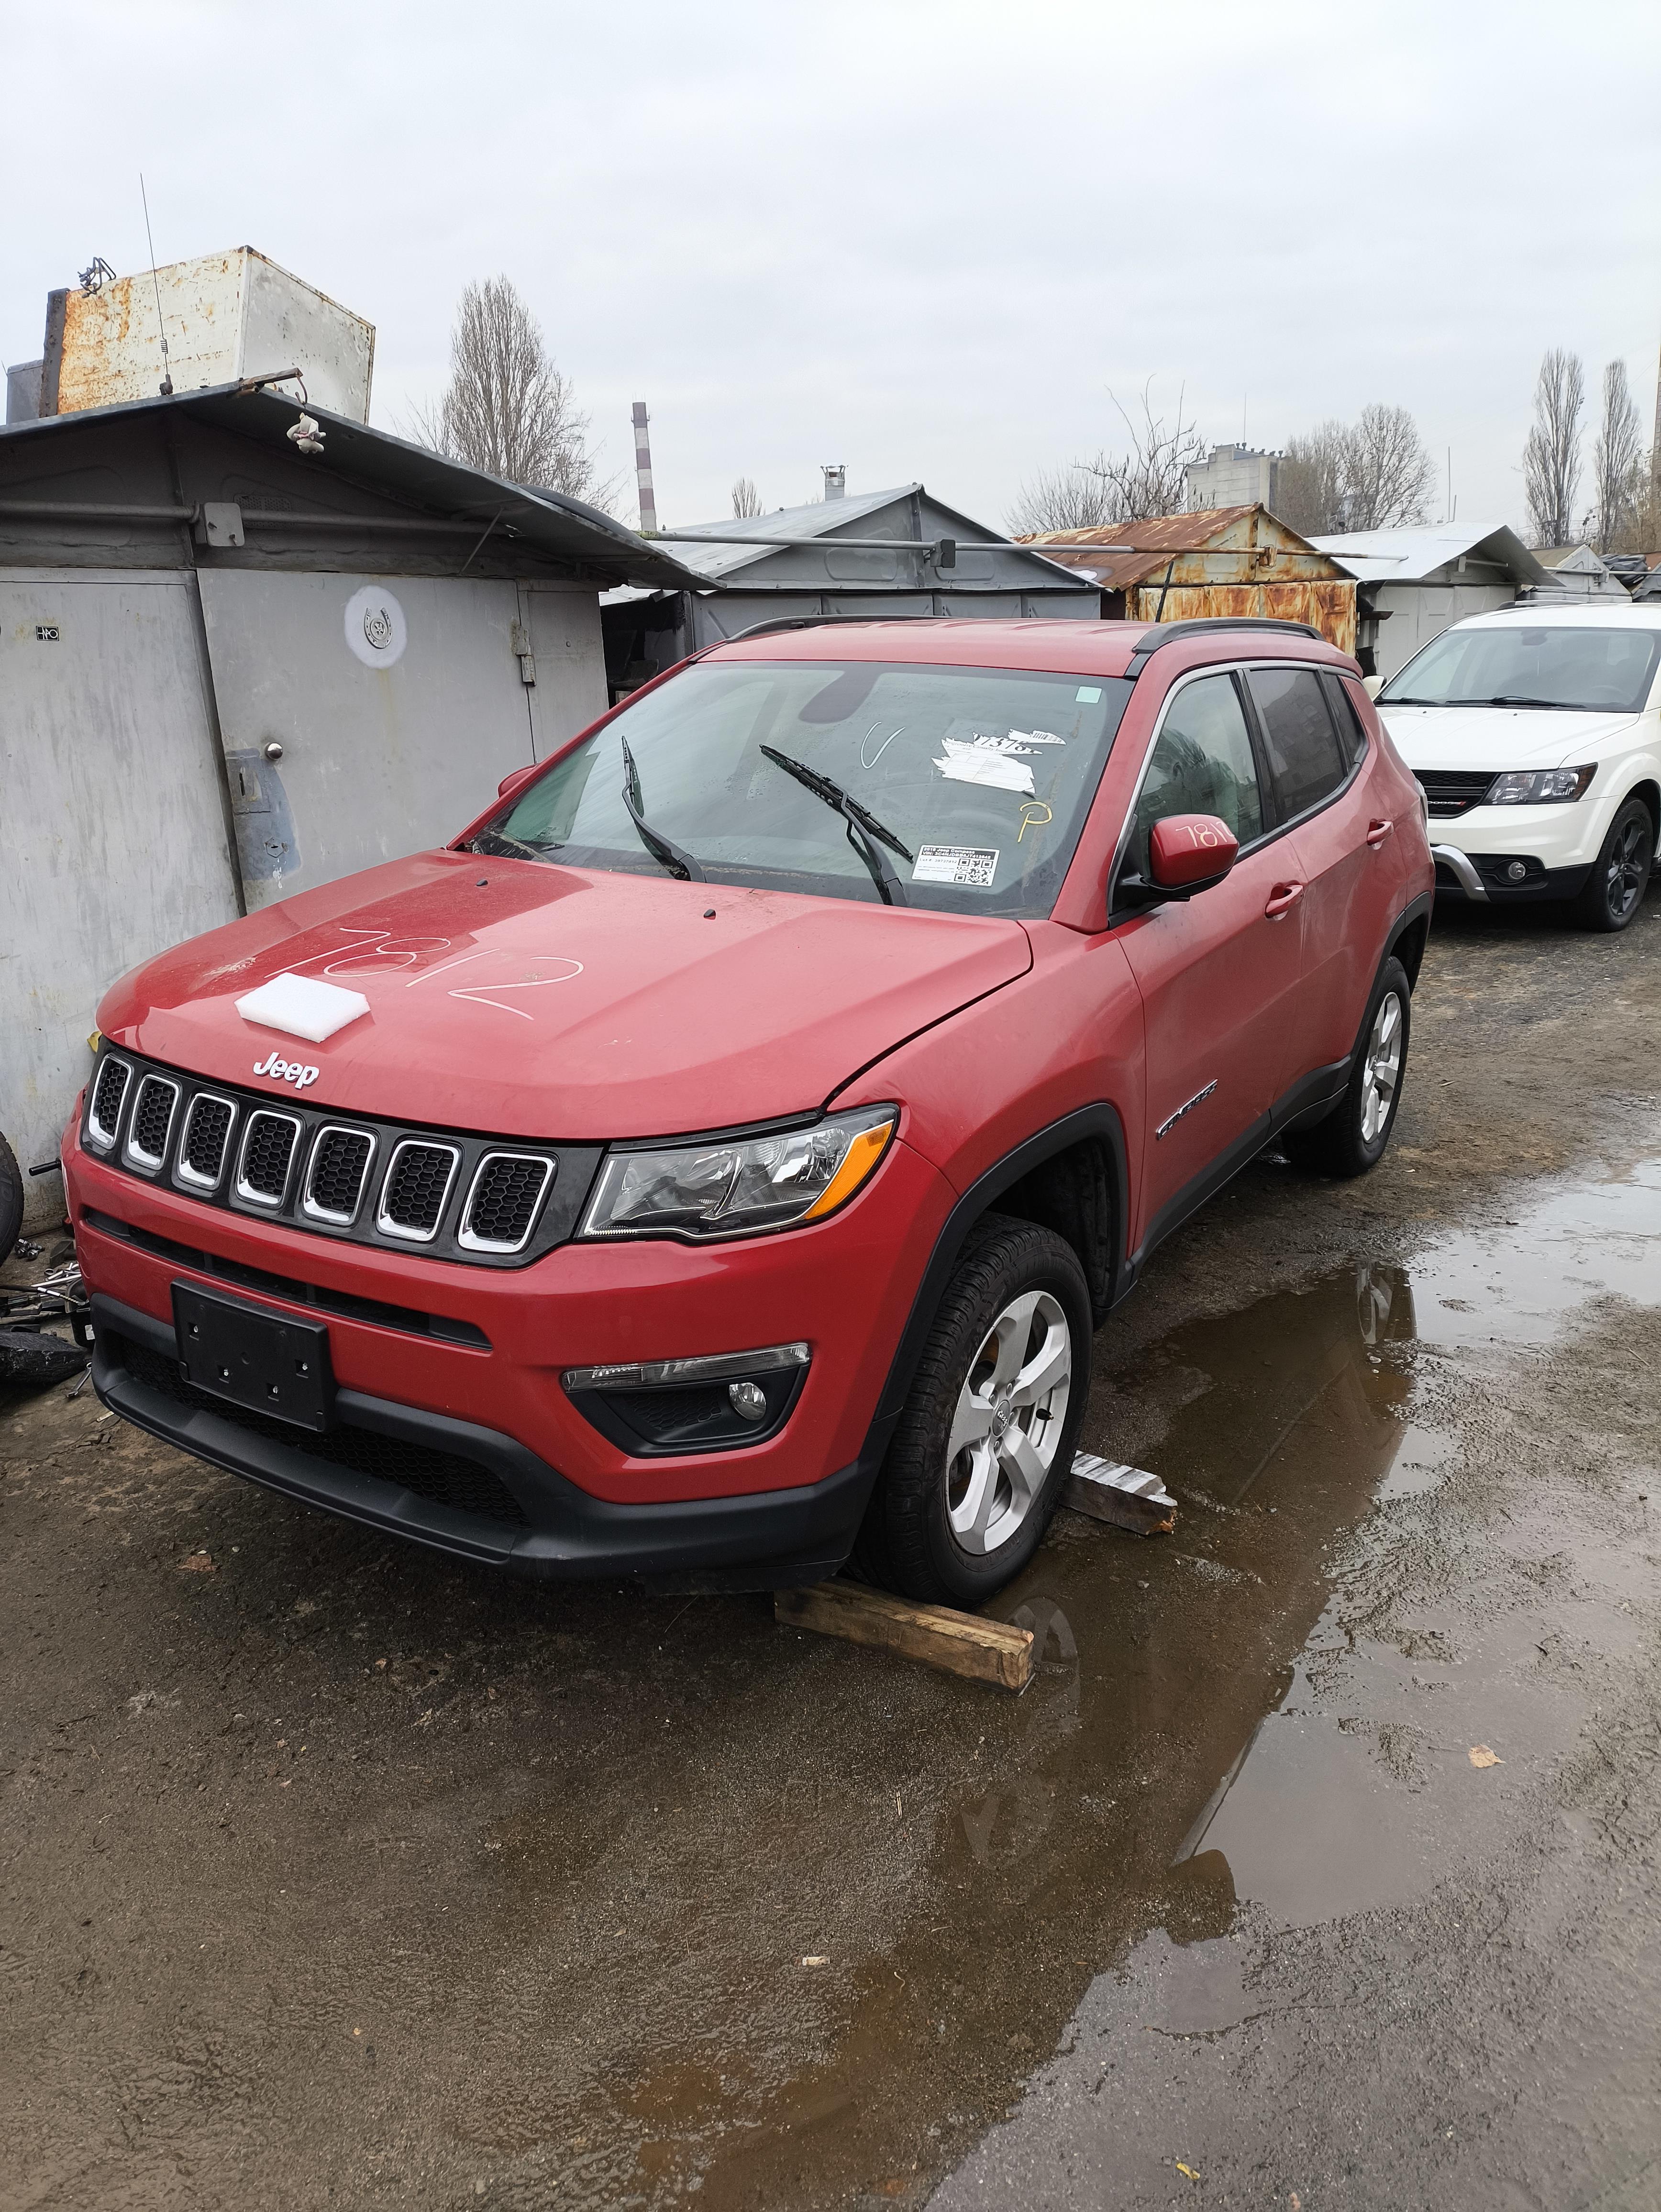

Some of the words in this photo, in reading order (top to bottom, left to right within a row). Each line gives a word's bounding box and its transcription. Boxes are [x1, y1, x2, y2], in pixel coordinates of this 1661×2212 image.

[1017, 802, 1052, 843] P
[264, 928, 584, 1020] 7812
[253, 1051, 320, 1090] Jeep
